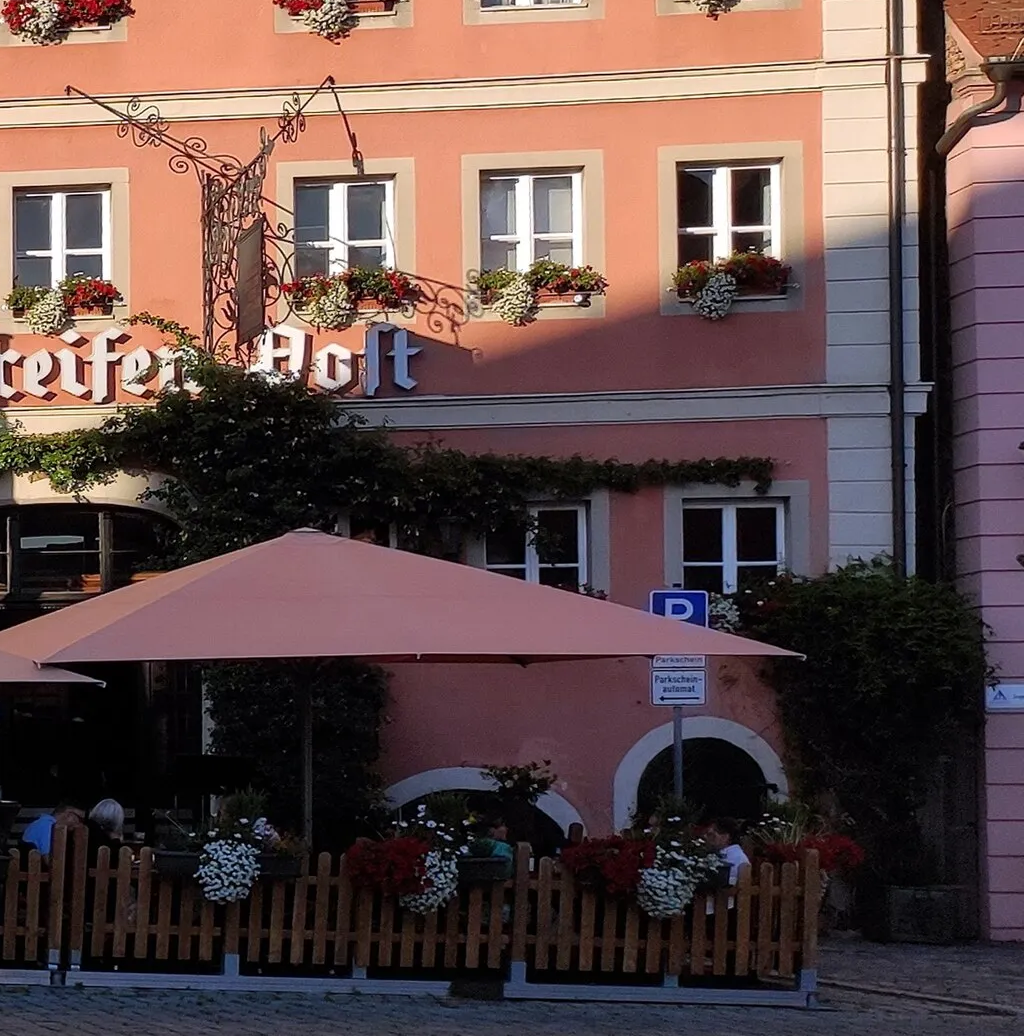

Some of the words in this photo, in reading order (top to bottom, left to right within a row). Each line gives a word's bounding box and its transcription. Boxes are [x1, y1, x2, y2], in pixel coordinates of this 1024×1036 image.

[664, 597, 694, 621] P
[655, 656, 703, 664] Parkschein
[654, 675, 703, 684] Parkschein-
[662, 684, 696, 693] automat
